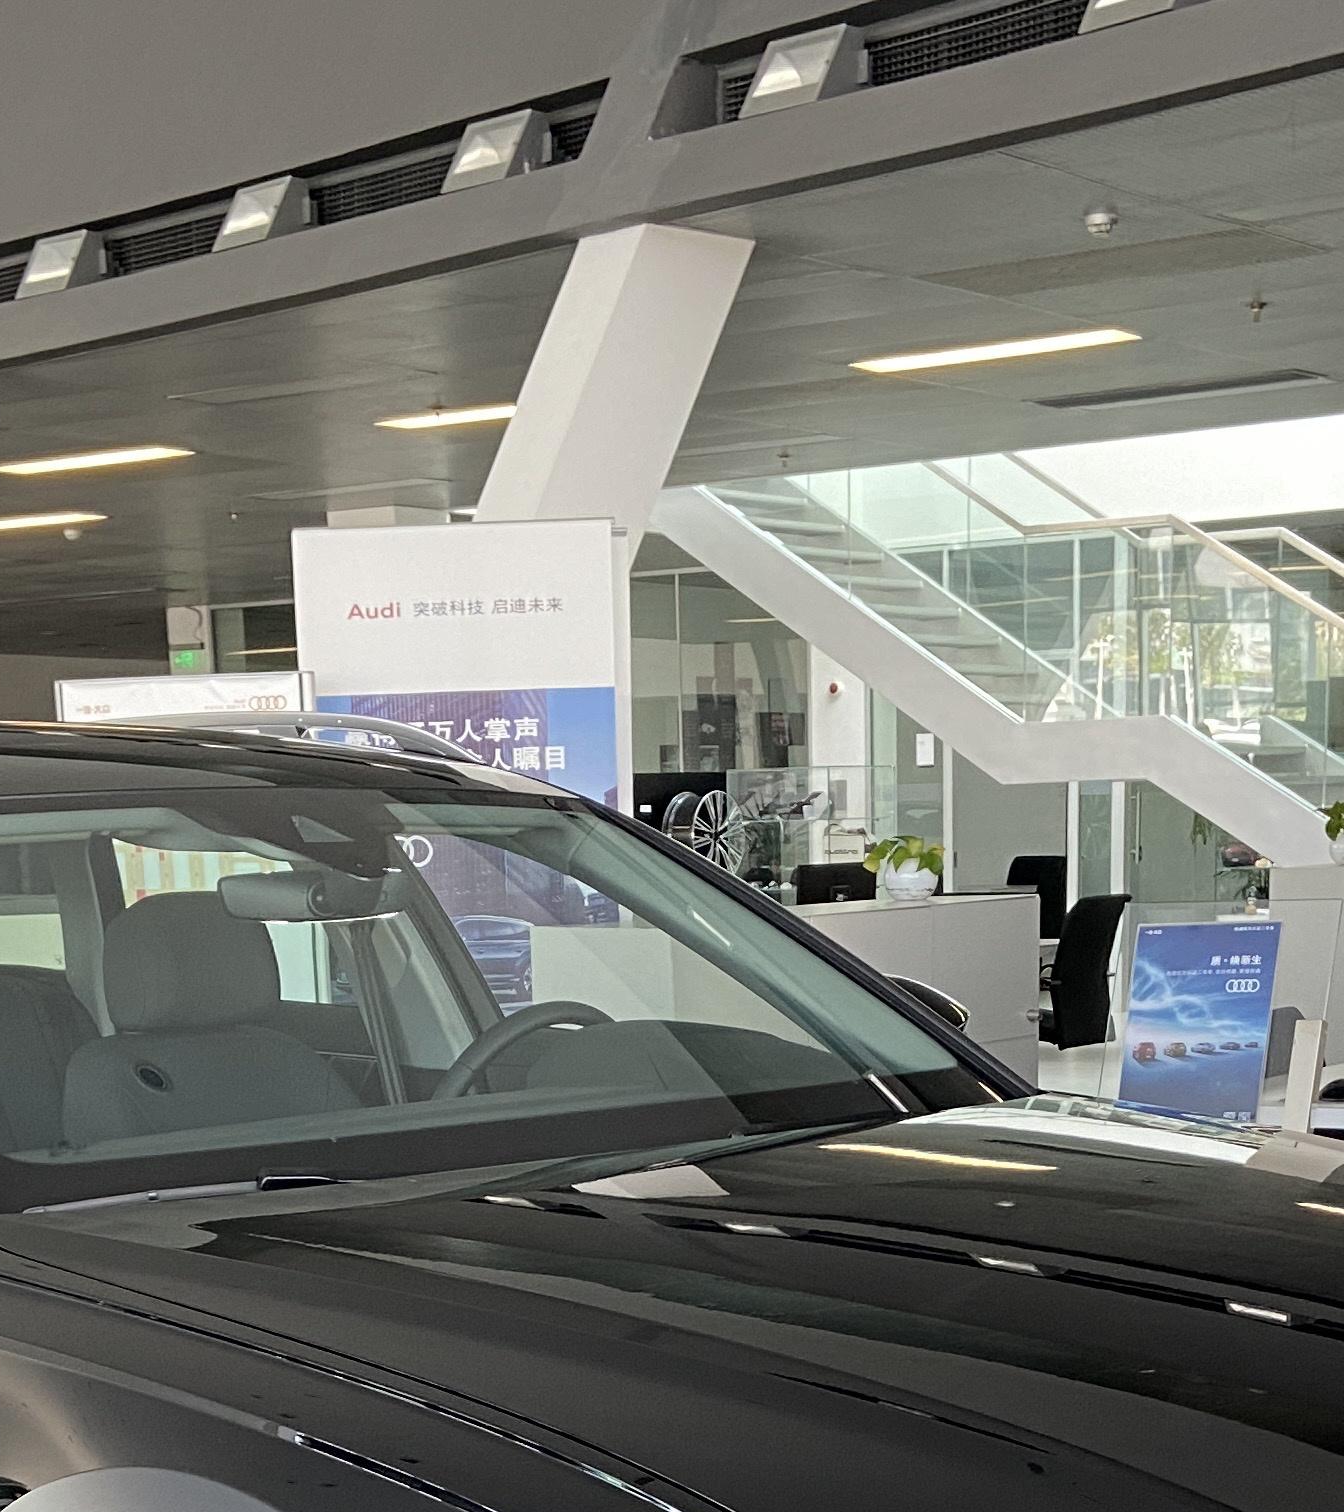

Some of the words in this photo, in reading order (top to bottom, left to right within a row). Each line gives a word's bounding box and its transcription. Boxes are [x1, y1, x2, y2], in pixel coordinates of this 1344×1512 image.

[348, 602, 401, 620] Audi
[413, 600, 485, 617] 突破科技
[490, 597, 565, 615] 启迪未来
[408, 716, 541, 742] 万人掌声
